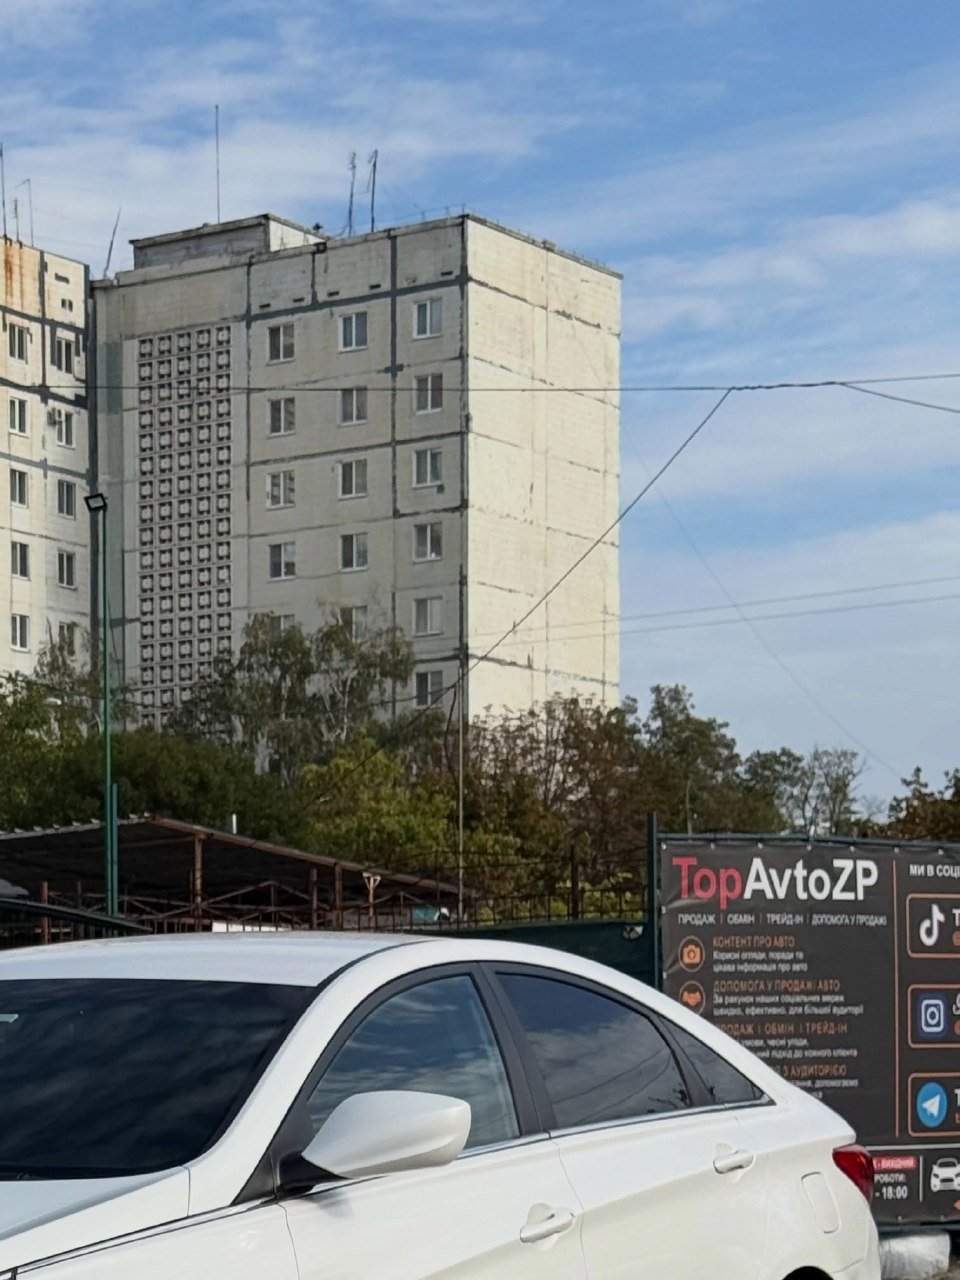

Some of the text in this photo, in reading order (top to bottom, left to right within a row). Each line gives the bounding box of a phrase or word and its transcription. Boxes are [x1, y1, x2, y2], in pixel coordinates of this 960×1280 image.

[909, 863, 925, 877] МИ
[926, 864, 935, 877] В
[672, 856, 879, 910] TopAvtoZP
[678, 913, 715, 925] ПРОДАЖ
[727, 914, 755, 925] ОБМІН
[766, 912, 804, 925] ТРЕЙД-ІН
[811, 914, 849, 926] ДОПОМОГА
[713, 936, 795, 948] КОНТЕНТ ПРО АВТО
[713, 980, 764, 993] ДОПОМОГА
[817, 979, 840, 991] АВТО
[764, 1023, 794, 1033] ОБМІН
[805, 1021, 847, 1034] ТРЕЙД-ІН
[882, 1185, 908, 1200] 18:00
